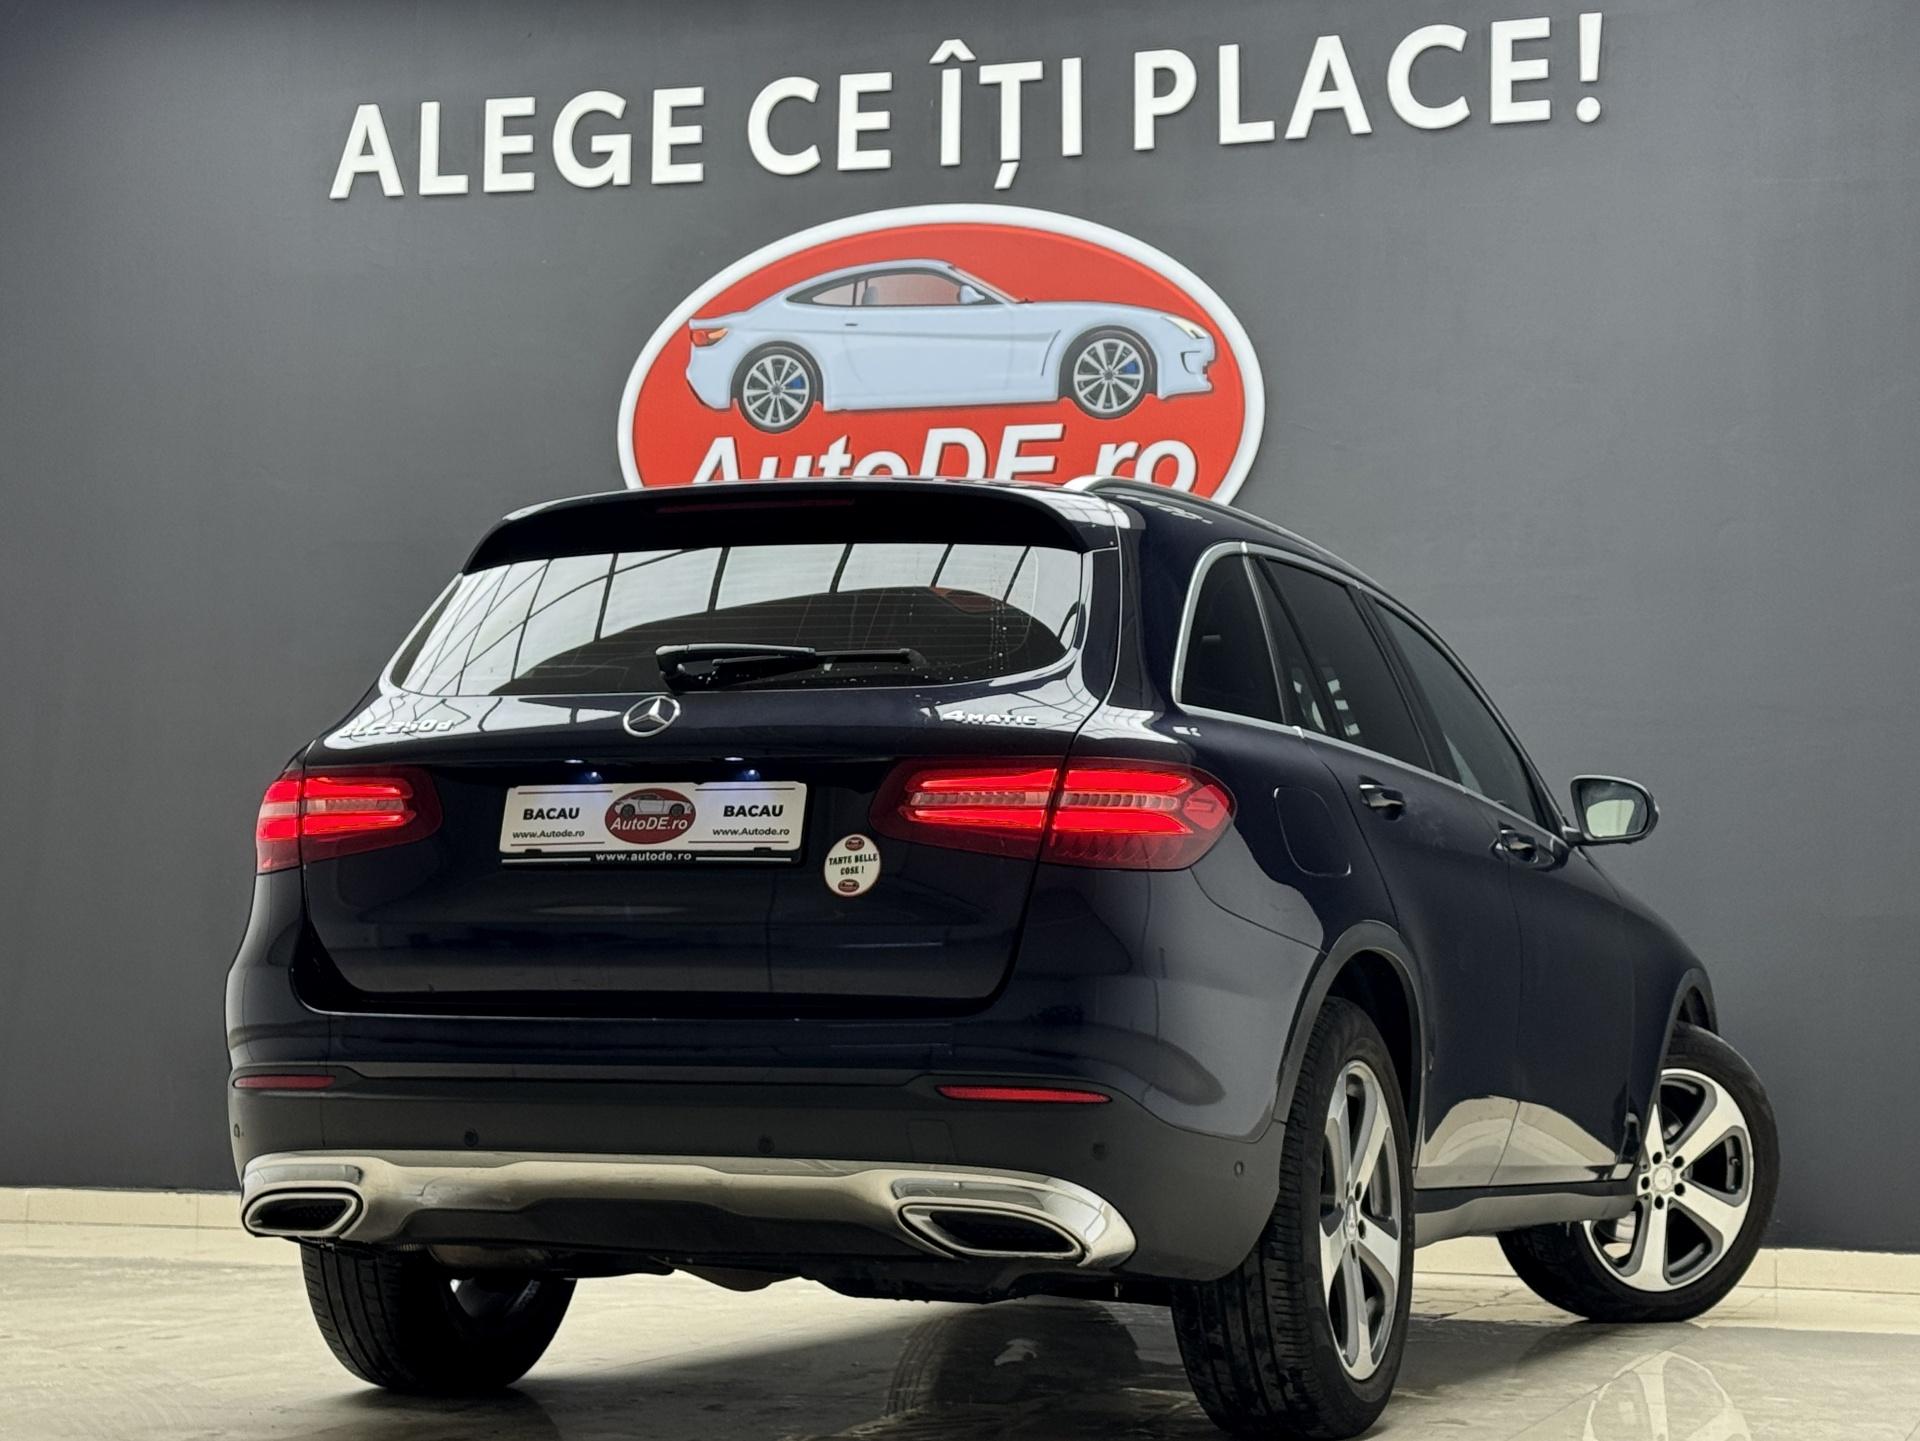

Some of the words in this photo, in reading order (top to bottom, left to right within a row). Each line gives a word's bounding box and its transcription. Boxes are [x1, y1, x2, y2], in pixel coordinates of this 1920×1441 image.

[329, 86, 705, 200] ALEGE
[747, 71, 893, 176] CE
[929, 38, 1083, 190] ÎȚI
[1133, 12, 1603, 153] PLACE!
[692, 423, 1197, 495] AtDEro
[942, 710, 1038, 727] 4MATIC
[523, 807, 580, 821] BACAU
[723, 805, 784, 818] BACAU
[610, 816, 688, 831] AutoDE.ro
[512, 829, 585, 839] www.Autode.ro
[712, 827, 790, 836] www.Autode.ro
[595, 852, 692, 862] www.autode.ro
[829, 855, 852, 866] TANTE
[855, 853, 878, 864] BELLE
[840, 866, 859, 876] COSE
